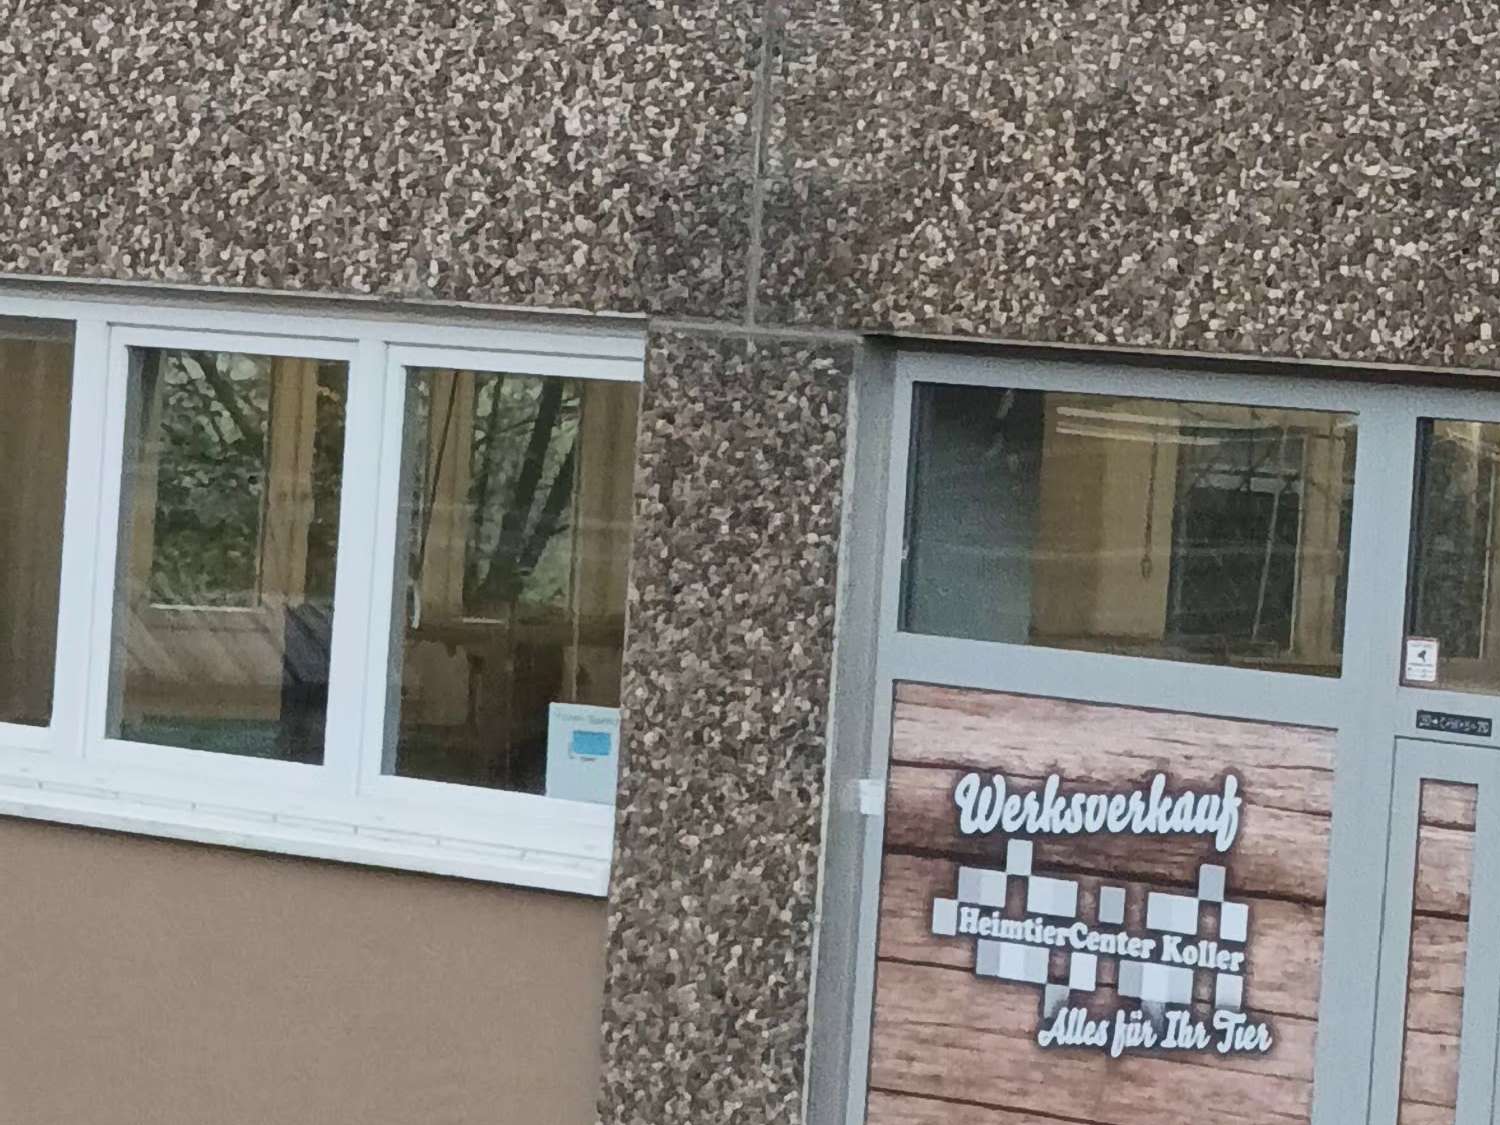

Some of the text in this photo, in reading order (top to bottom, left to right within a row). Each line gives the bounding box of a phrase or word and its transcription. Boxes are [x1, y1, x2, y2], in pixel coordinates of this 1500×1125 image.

[954, 772, 1242, 852] Werksverkauf
[1161, 936, 1246, 972] Koller
[1038, 1007, 1273, 1058] Alles für Ihr Tier
